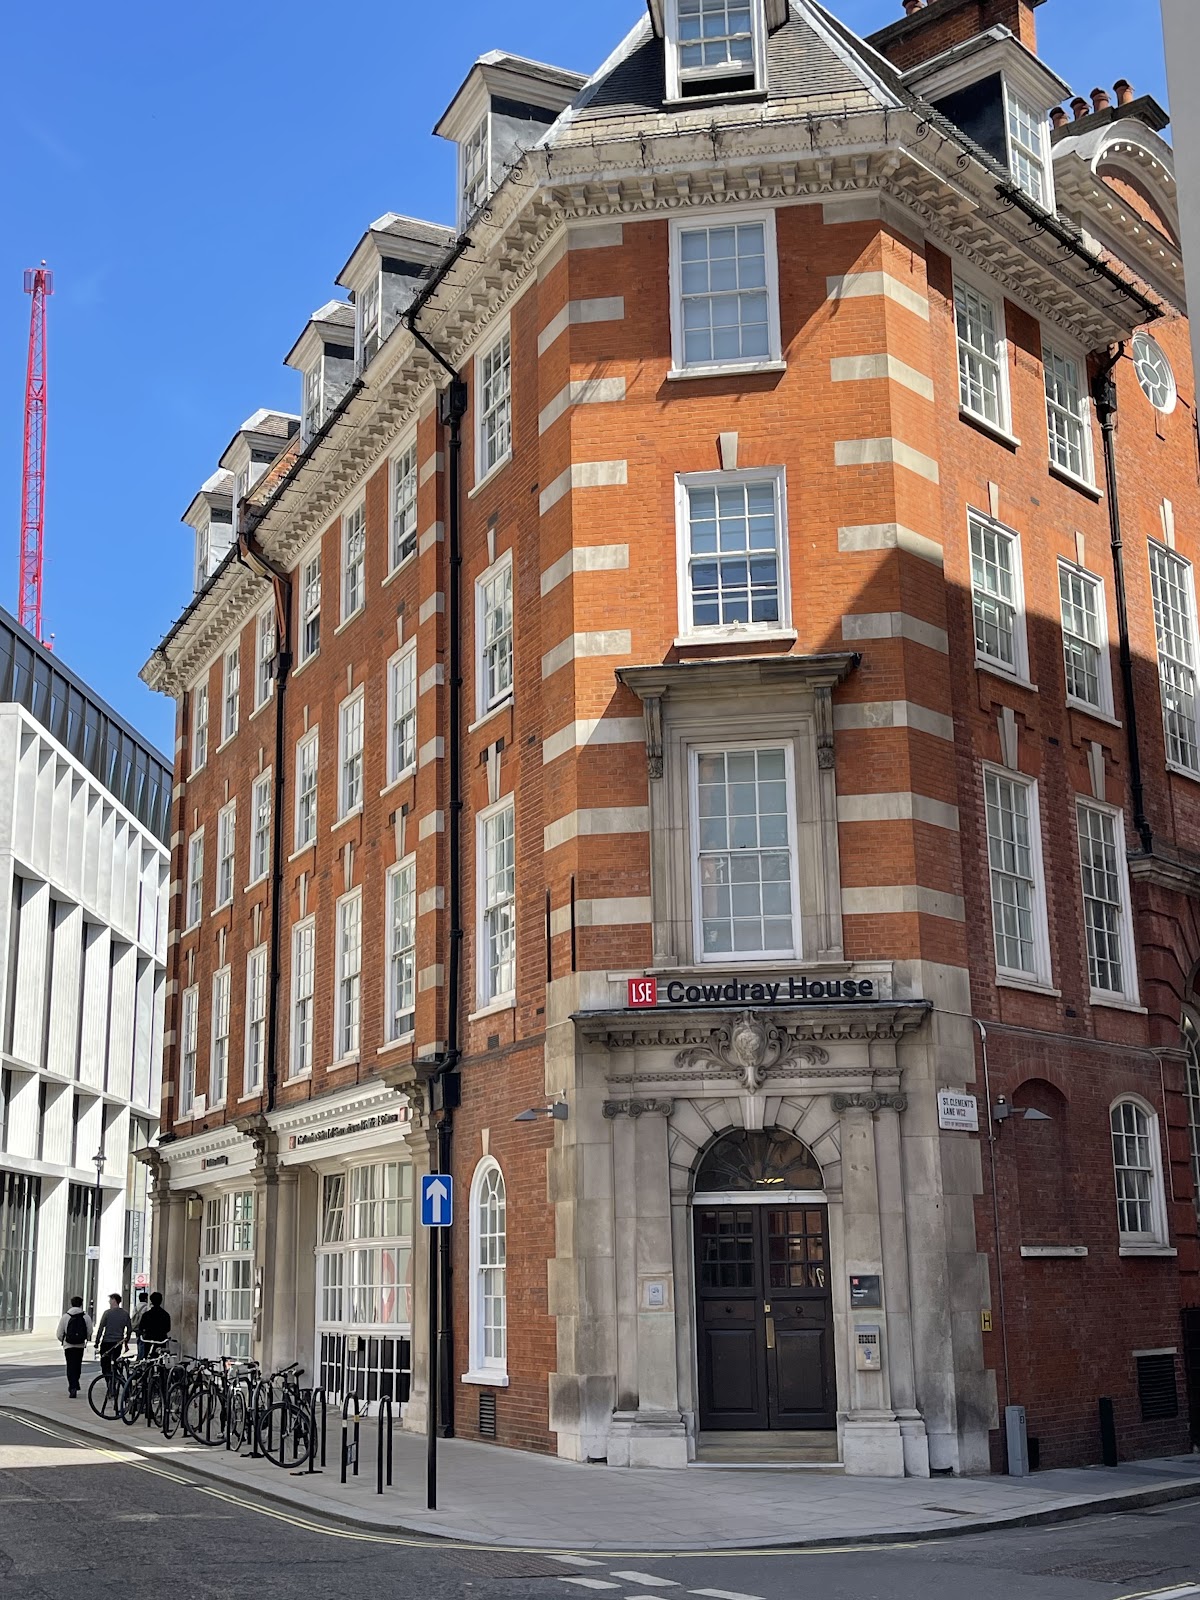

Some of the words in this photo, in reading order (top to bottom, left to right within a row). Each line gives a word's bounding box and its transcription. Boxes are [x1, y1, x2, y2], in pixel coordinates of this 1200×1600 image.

[632, 983, 652, 1002] LSE
[667, 978, 780, 1005] Cowdray
[789, 977, 873, 998] House
[950, 1098, 973, 1108] CLEMENT'S
[944, 1108, 955, 1116] LANE
[956, 1108, 966, 1117] WC2
[983, 1313, 990, 1329] H
